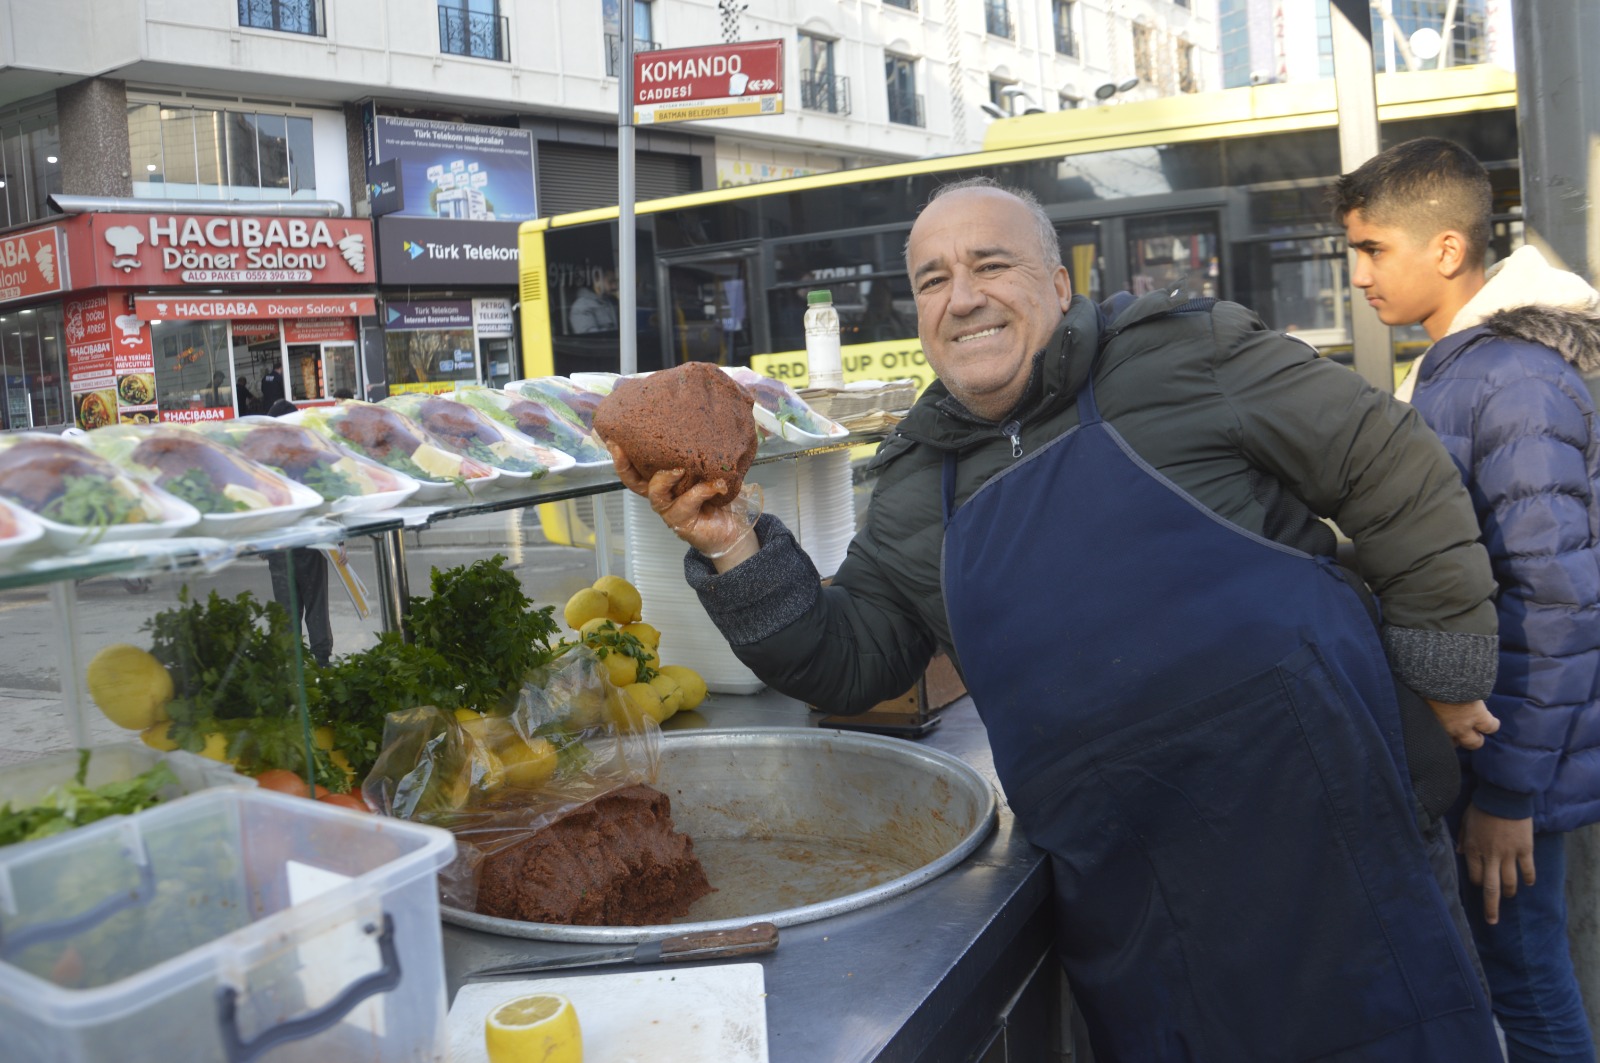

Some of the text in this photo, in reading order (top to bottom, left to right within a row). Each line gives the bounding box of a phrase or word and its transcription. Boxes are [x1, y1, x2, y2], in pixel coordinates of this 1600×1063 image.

[641, 54, 741, 83] KOMANDO
[639, 83, 692, 101] CADDESİ
[658, 110, 687, 120] BATMAN
[688, 106, 729, 117] BELEDİYESİ
[414, 129, 431, 139] Türk
[432, 130, 463, 142] Telekom
[149, 216, 334, 249] HACIBABA
[163, 247, 327, 271] Döner Salonu
[426, 243, 519, 261] Türk Telekom
[187, 271, 307, 281] ALO PAKET 0552 396 12 72
[175, 302, 345, 317] HACIBABA Döner Salonu
[414, 306, 459, 315] Türk Telekom
[479, 312, 509, 320] TELEKOM
[74, 342, 107, 357] HACIBABA
[115, 352, 151, 362] AİLE YERİMİZ
[116, 360, 151, 369] MEVCUTTUR
[766, 362, 806, 379] SRD
[170, 409, 219, 422] HACIBABA
